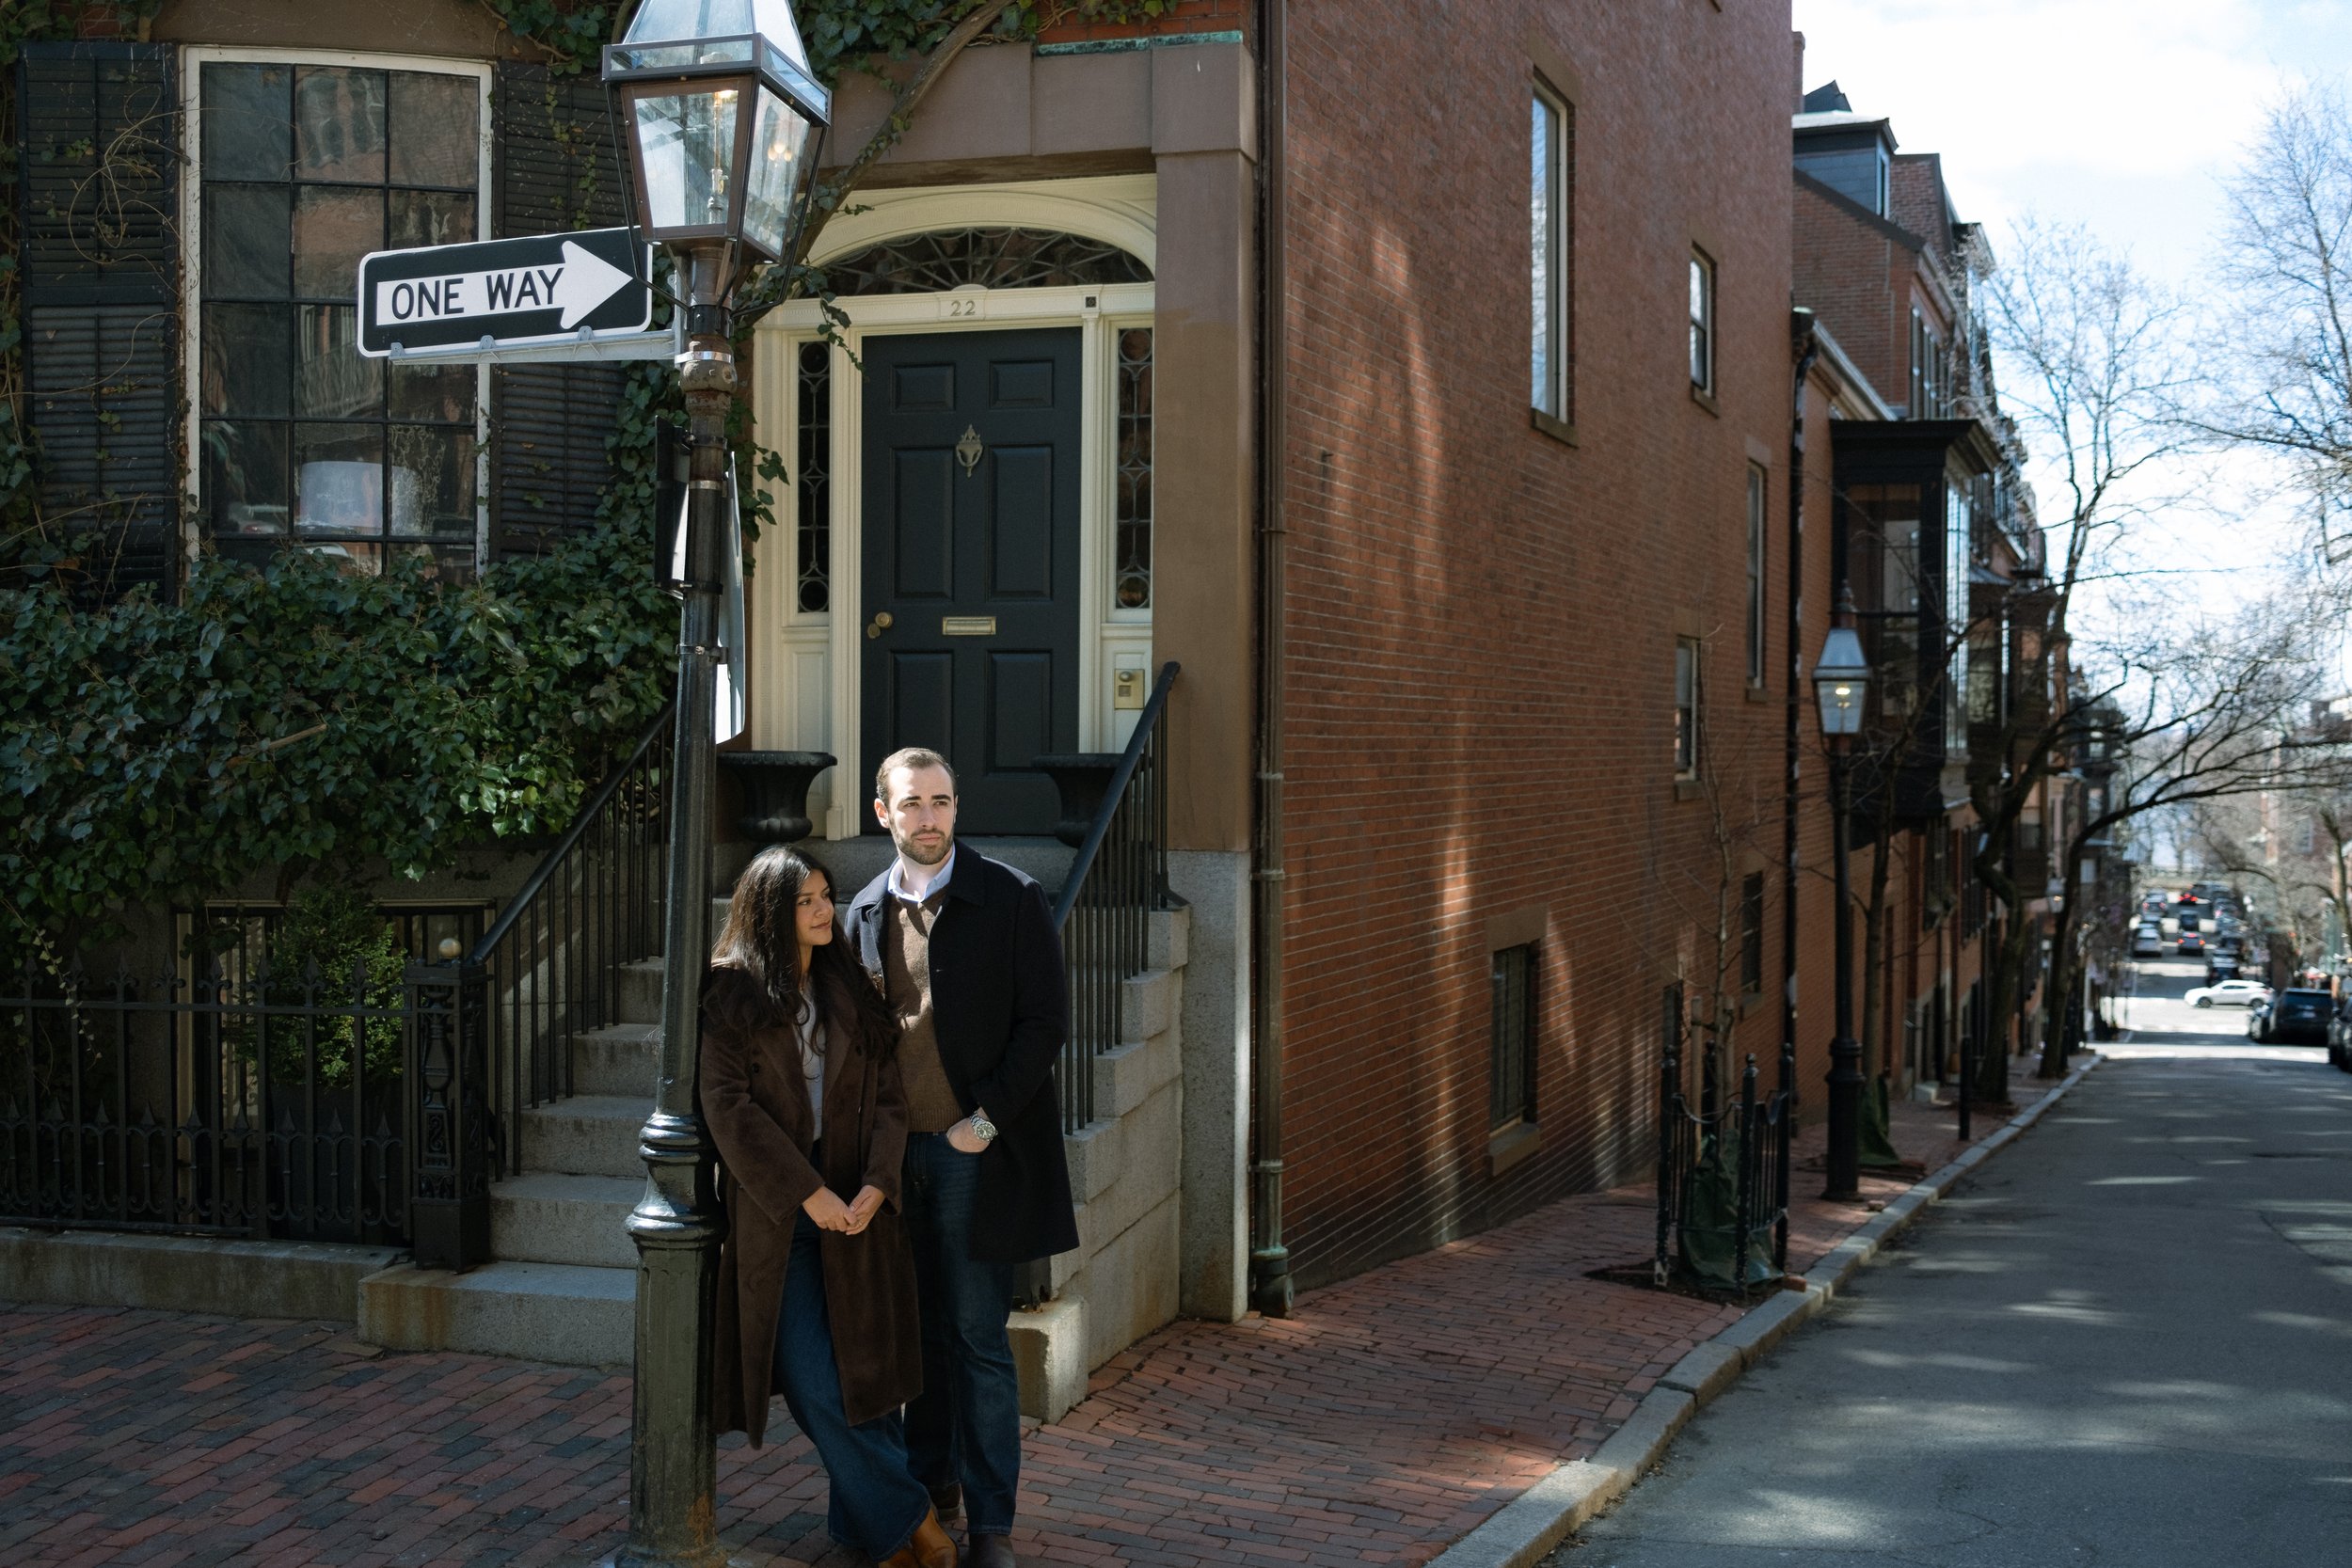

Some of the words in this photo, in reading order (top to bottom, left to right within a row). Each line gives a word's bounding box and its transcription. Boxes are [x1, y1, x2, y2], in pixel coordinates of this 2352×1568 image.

[391, 277, 464, 320] ONE
[485, 267, 564, 310] WAY
[950, 300, 977, 317] 22
